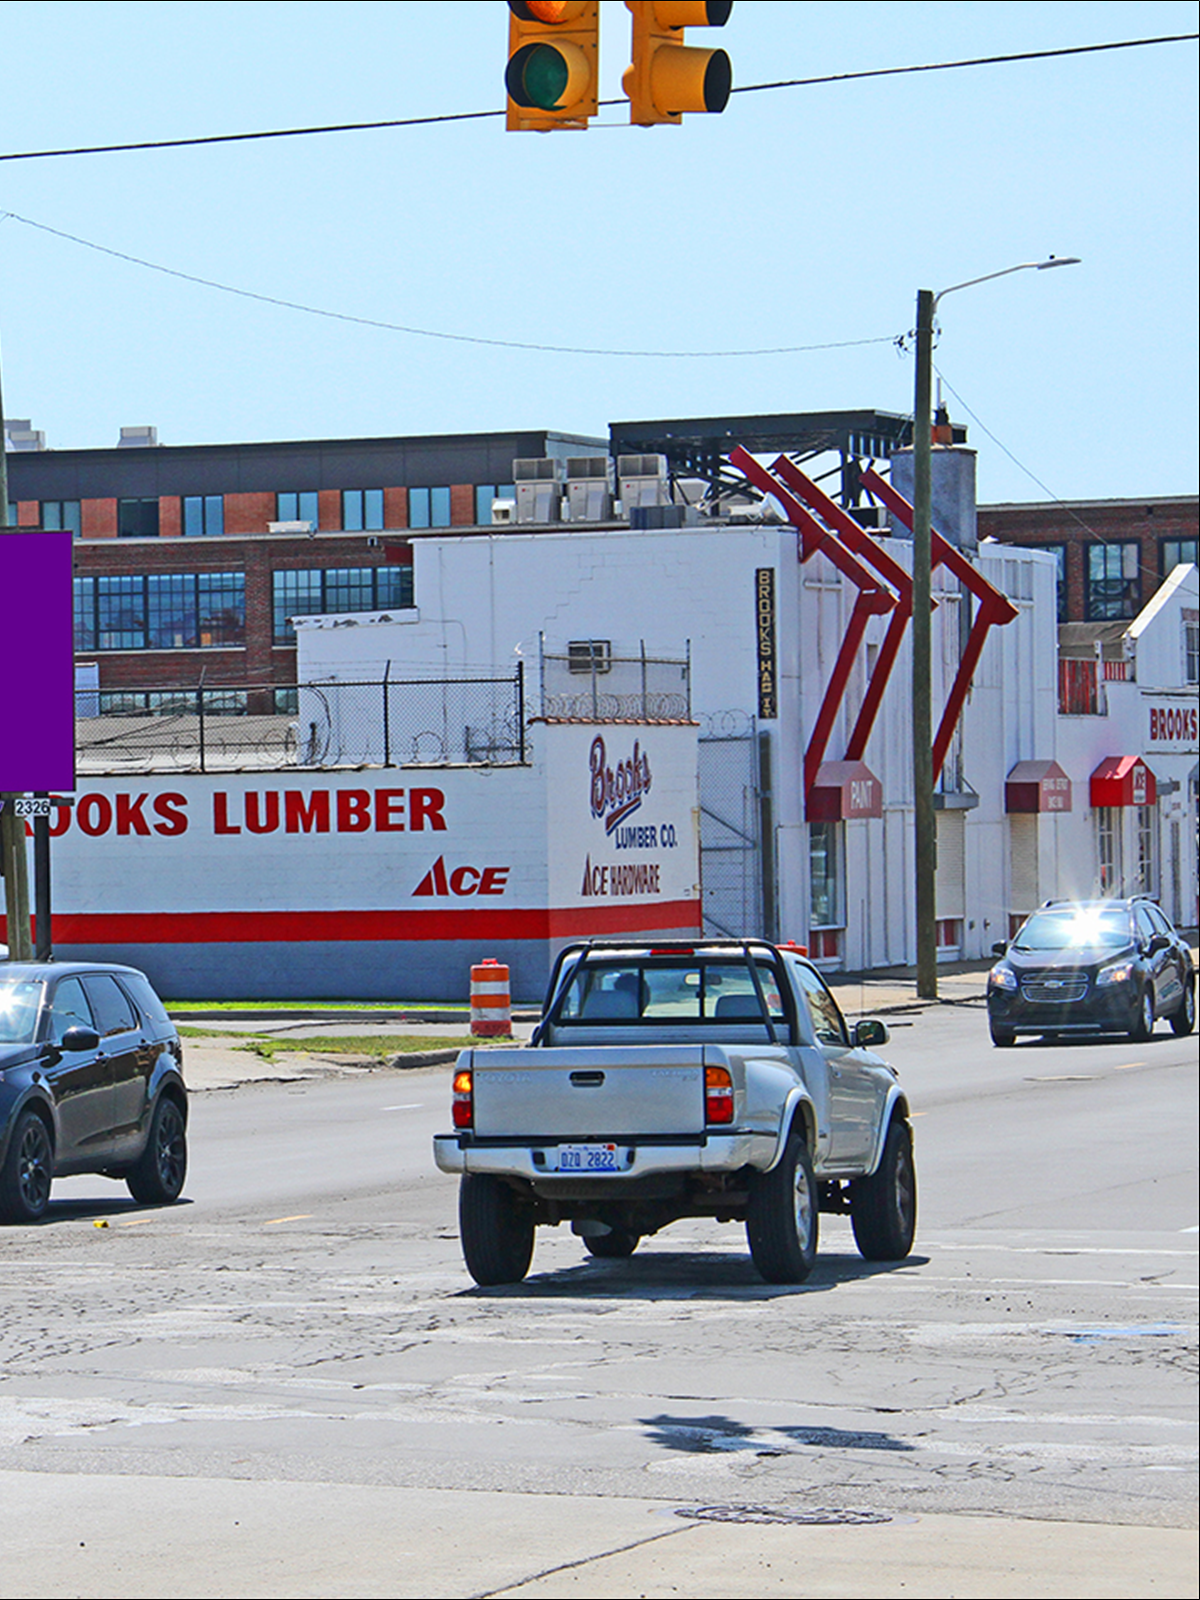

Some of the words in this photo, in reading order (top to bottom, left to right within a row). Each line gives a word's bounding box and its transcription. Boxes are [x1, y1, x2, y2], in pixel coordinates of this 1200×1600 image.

[758, 571, 772, 656] BROOKS
[1149, 708, 1198, 741] BROOKS
[589, 733, 653, 819] Brooks
[850, 780, 873, 809] PAINT
[16, 800, 51, 815] 2326
[213, 788, 448, 835] LUMBER
[615, 825, 658, 850] LUMBER
[660, 824, 679, 849] CO.
[411, 854, 511, 897] ACE
[581, 852, 609, 897] ACE
[610, 864, 661, 896] HARDWARE
[587, 1151, 615, 1167] 2822
